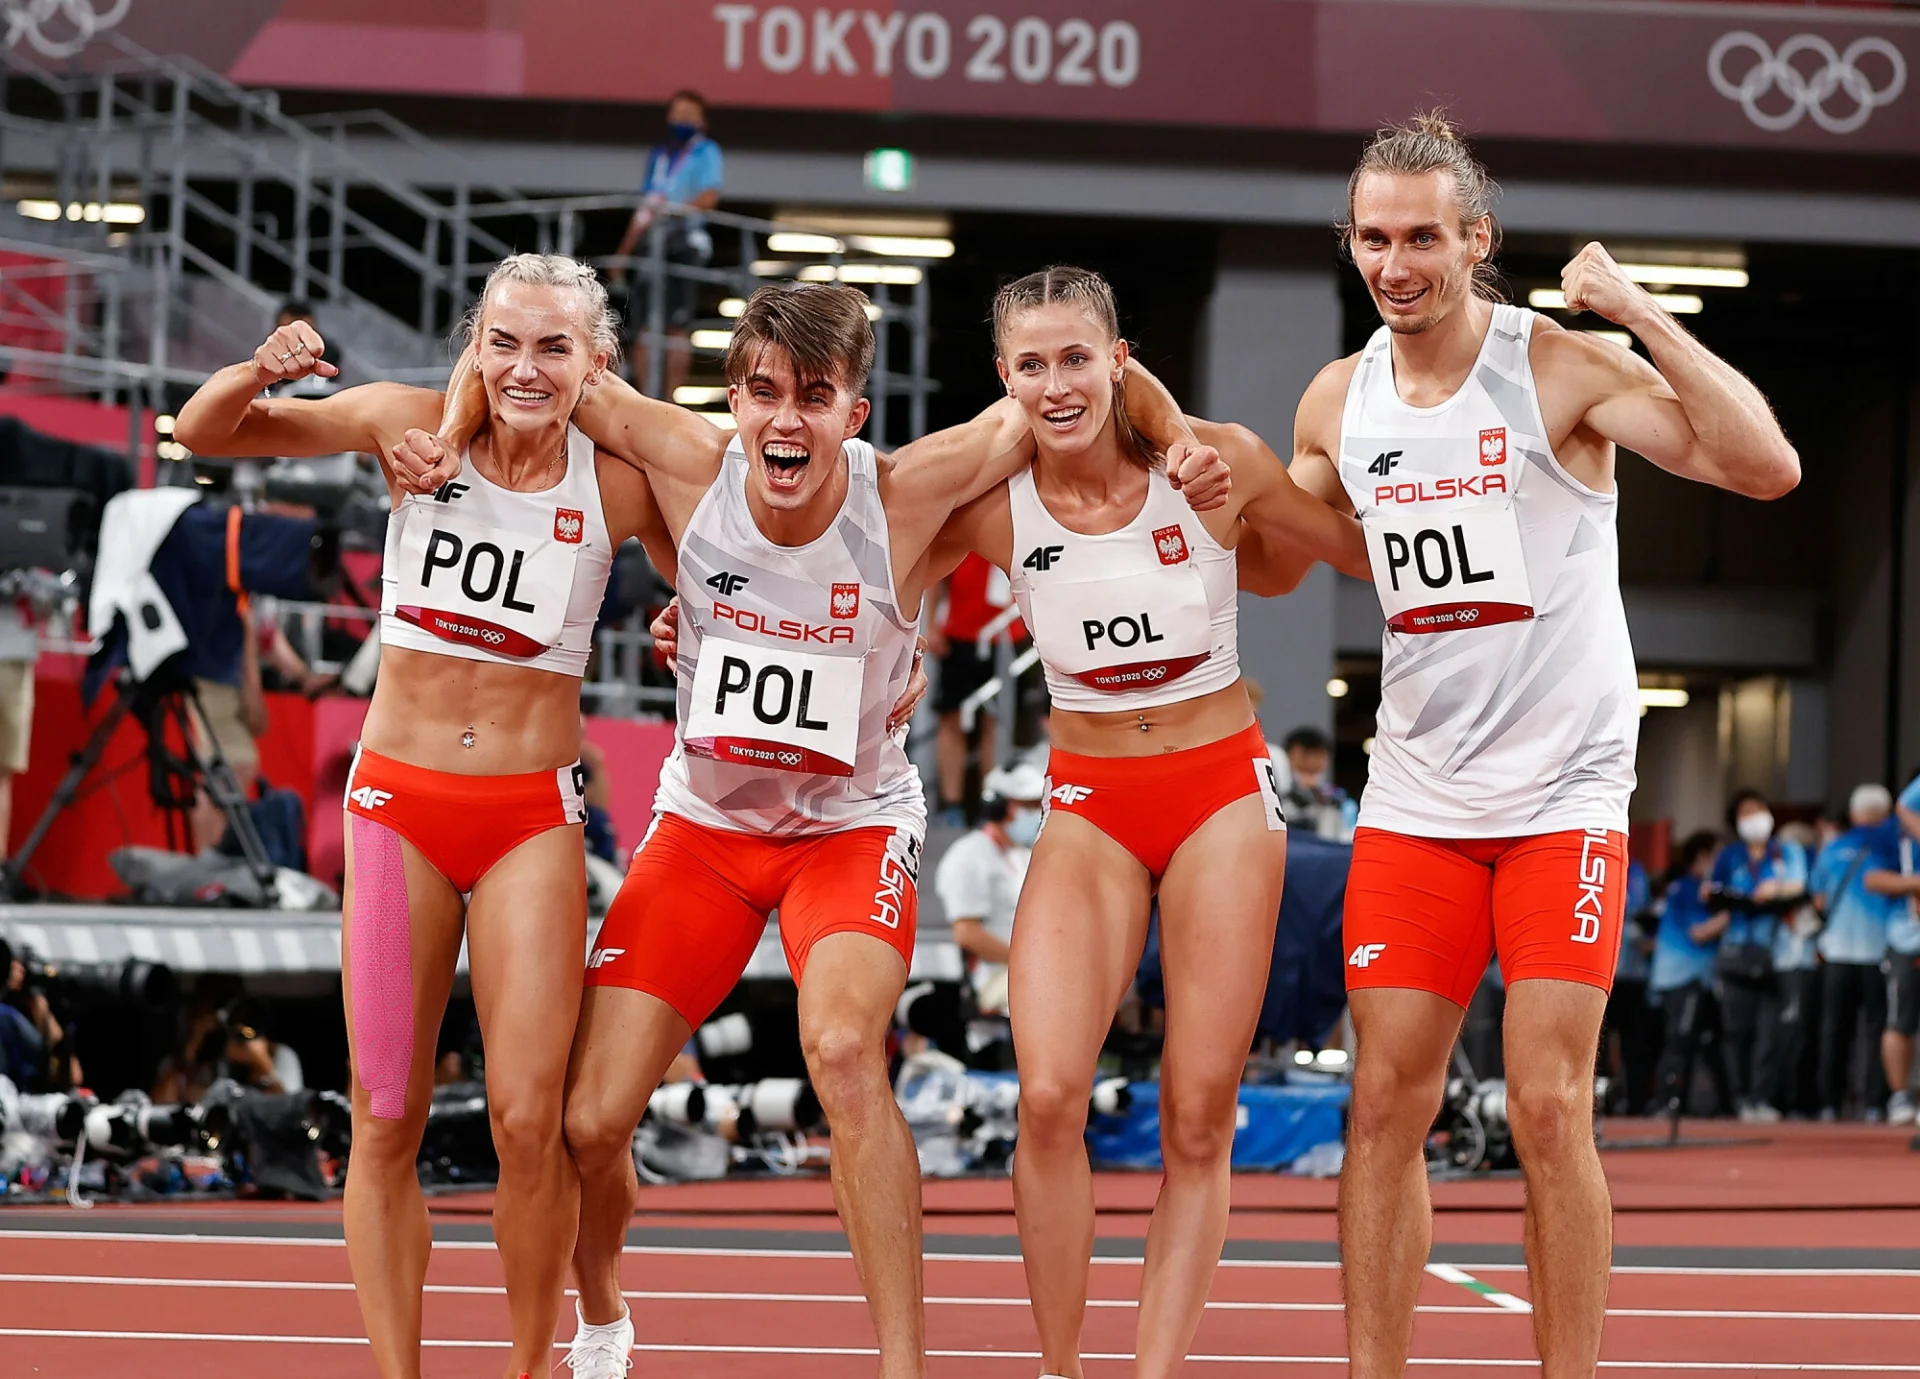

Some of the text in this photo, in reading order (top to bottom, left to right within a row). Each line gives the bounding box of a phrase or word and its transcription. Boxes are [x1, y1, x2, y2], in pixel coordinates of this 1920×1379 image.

[714, 4, 1140, 88] TOKYO 2020
[1480, 429, 1505, 437] POLSKA
[1368, 451, 1403, 476] 4F
[1375, 473, 1507, 506] POLSKA
[1154, 525, 1179, 537] POLSKA
[1022, 545, 1064, 571] 4F
[1383, 524, 1495, 592] POL
[421, 528, 535, 614] POL
[706, 571, 749, 596] 4F
[434, 617, 479, 637] TOKYO 2020
[713, 601, 855, 644] POLSKA
[1082, 612, 1164, 651] POL
[1413, 613, 1455, 626] TOKYO 2020
[1095, 672, 1141, 685] TOKYO 2020
[715, 655, 828, 731] POL
[729, 745, 775, 761] TOKYO 2020
[350, 785, 394, 810] 4F
[1051, 783, 1094, 805] 4F
[1570, 828, 1608, 944] LSKA
[1348, 944, 1387, 968] 4F
